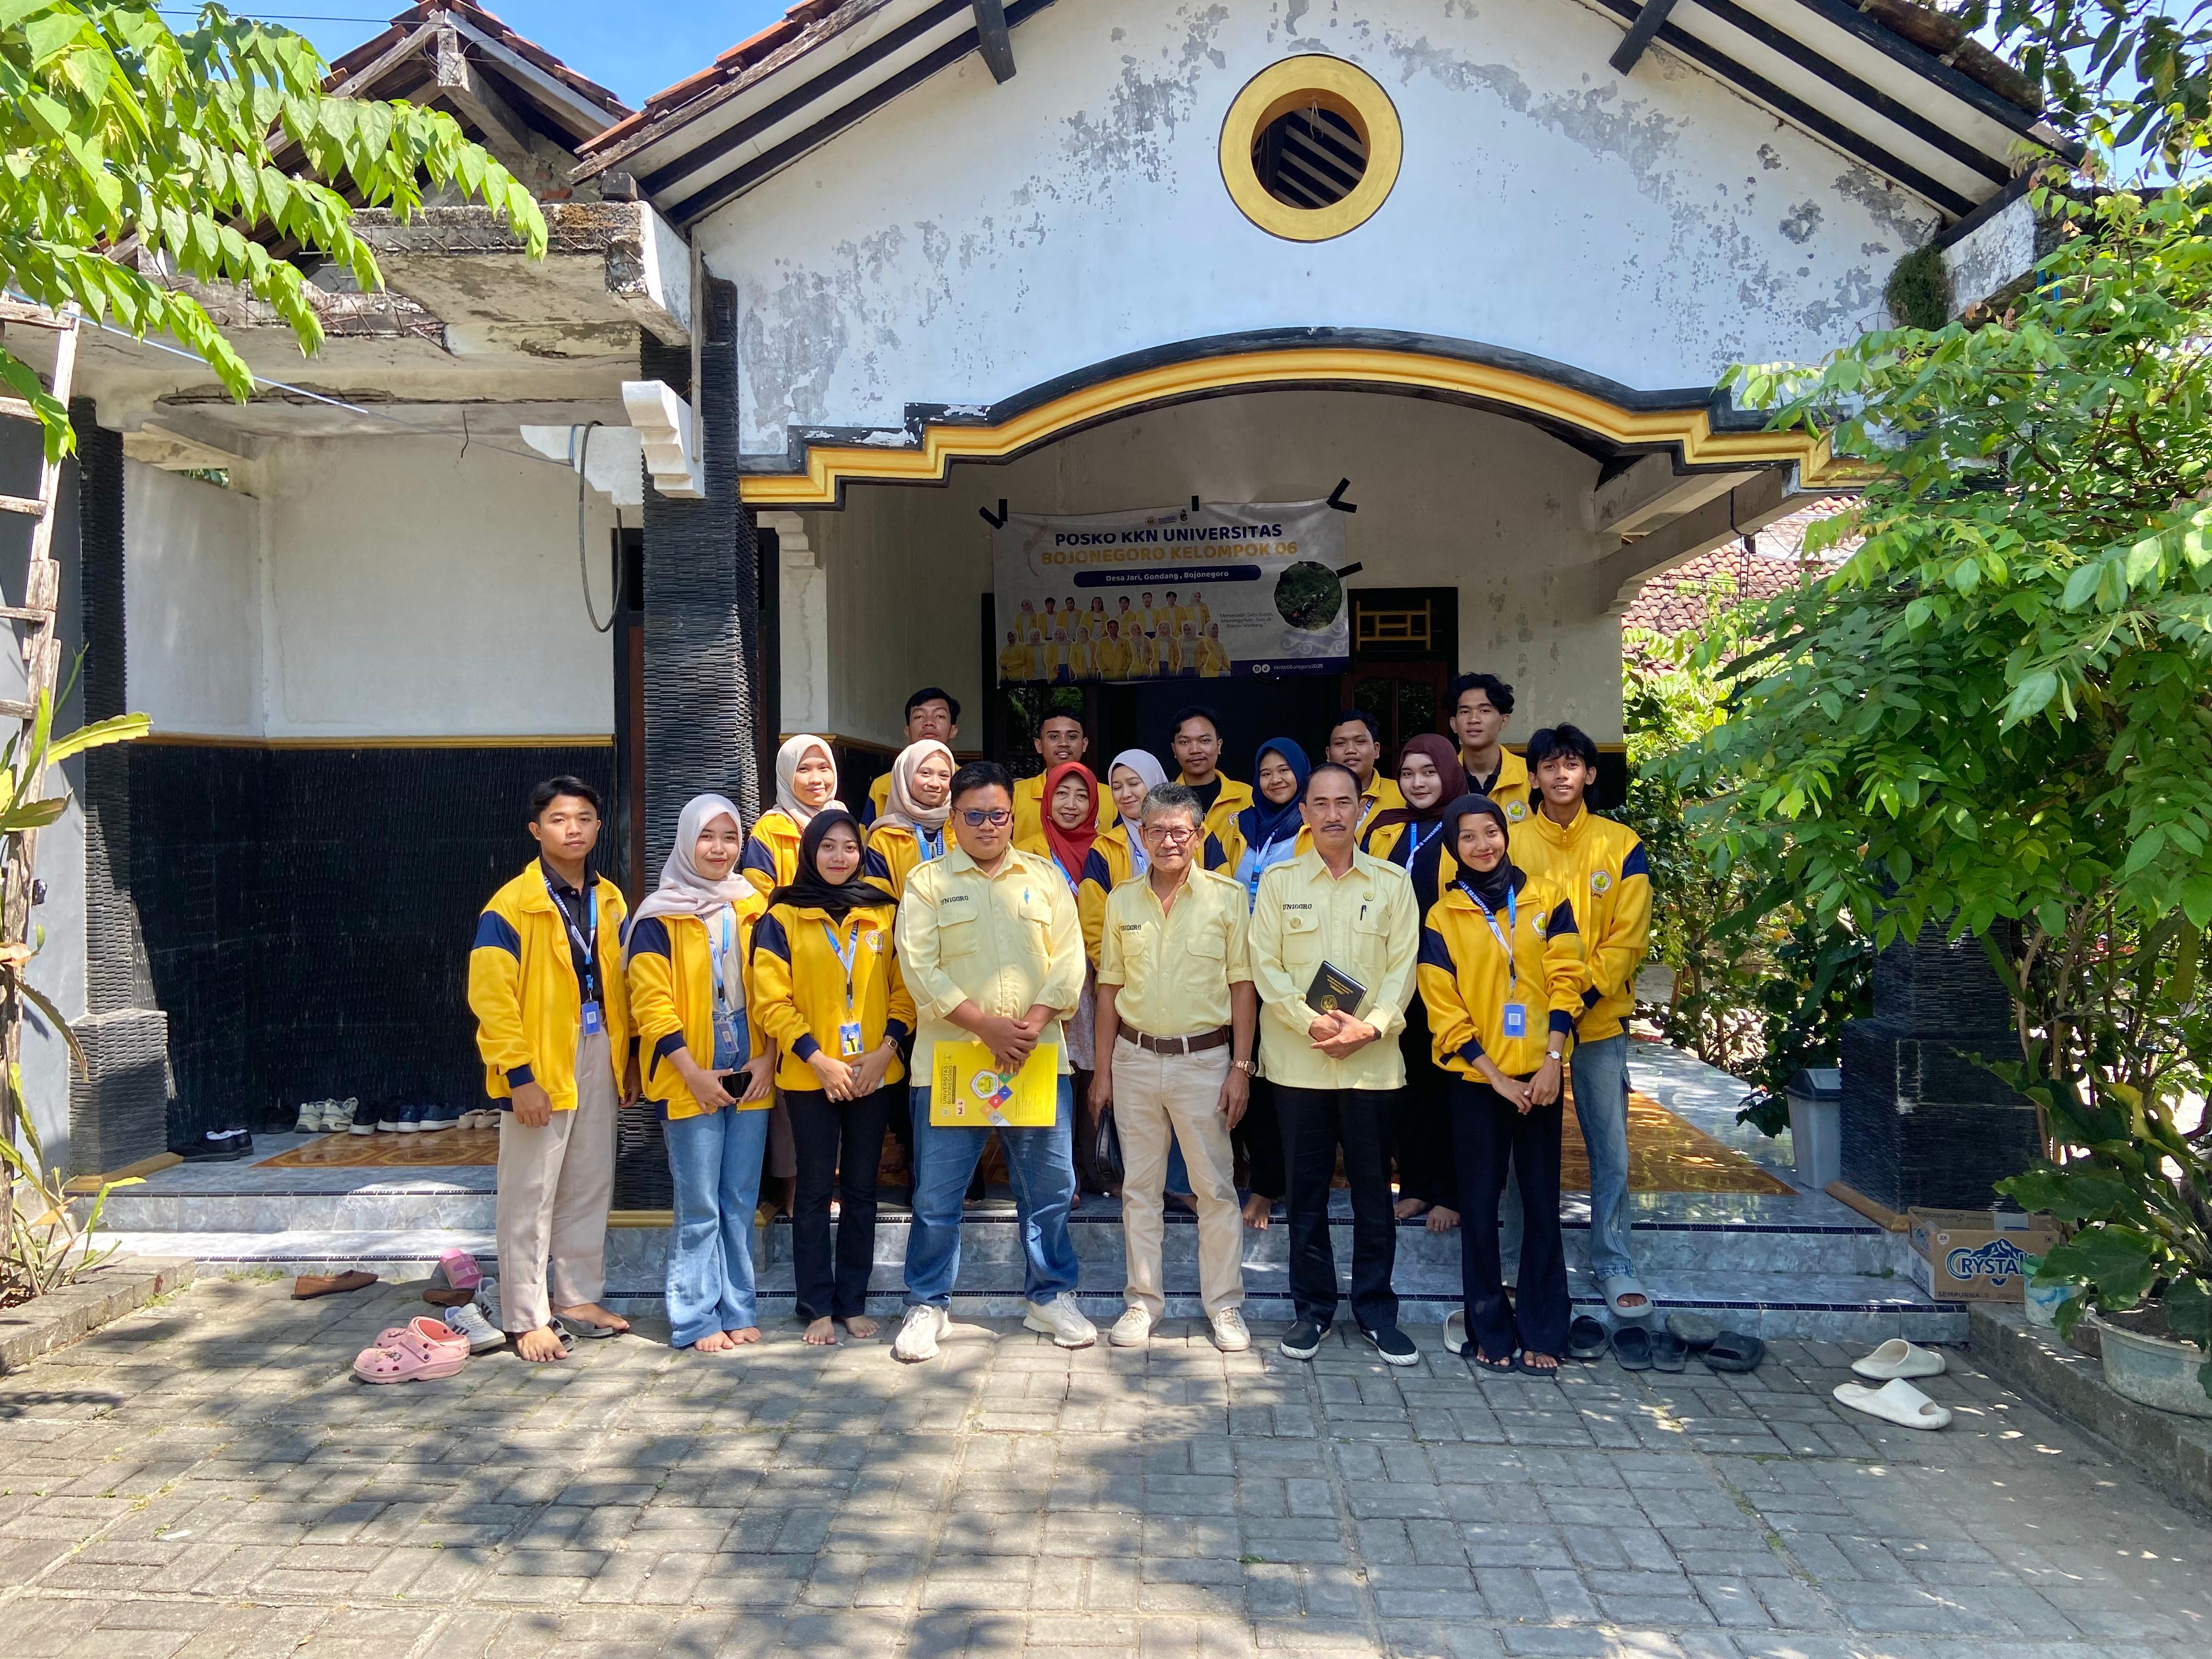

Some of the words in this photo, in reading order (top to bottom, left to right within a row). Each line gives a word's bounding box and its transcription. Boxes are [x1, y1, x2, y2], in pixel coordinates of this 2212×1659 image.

[1055, 533, 1116, 546] POSKO
[1121, 529, 1158, 543] KKN
[1164, 524, 1282, 541] UNIVERSITAS
[1042, 548, 1165, 565] BOJONEGORO
[1170, 543, 1271, 560] KELOMPOK
[1275, 541, 1298, 555] 06
[1144, 573, 1178, 581] Gondang
[1184, 571, 1229, 579] Bojonegoro
[940, 895, 969, 905] UNIGORO
